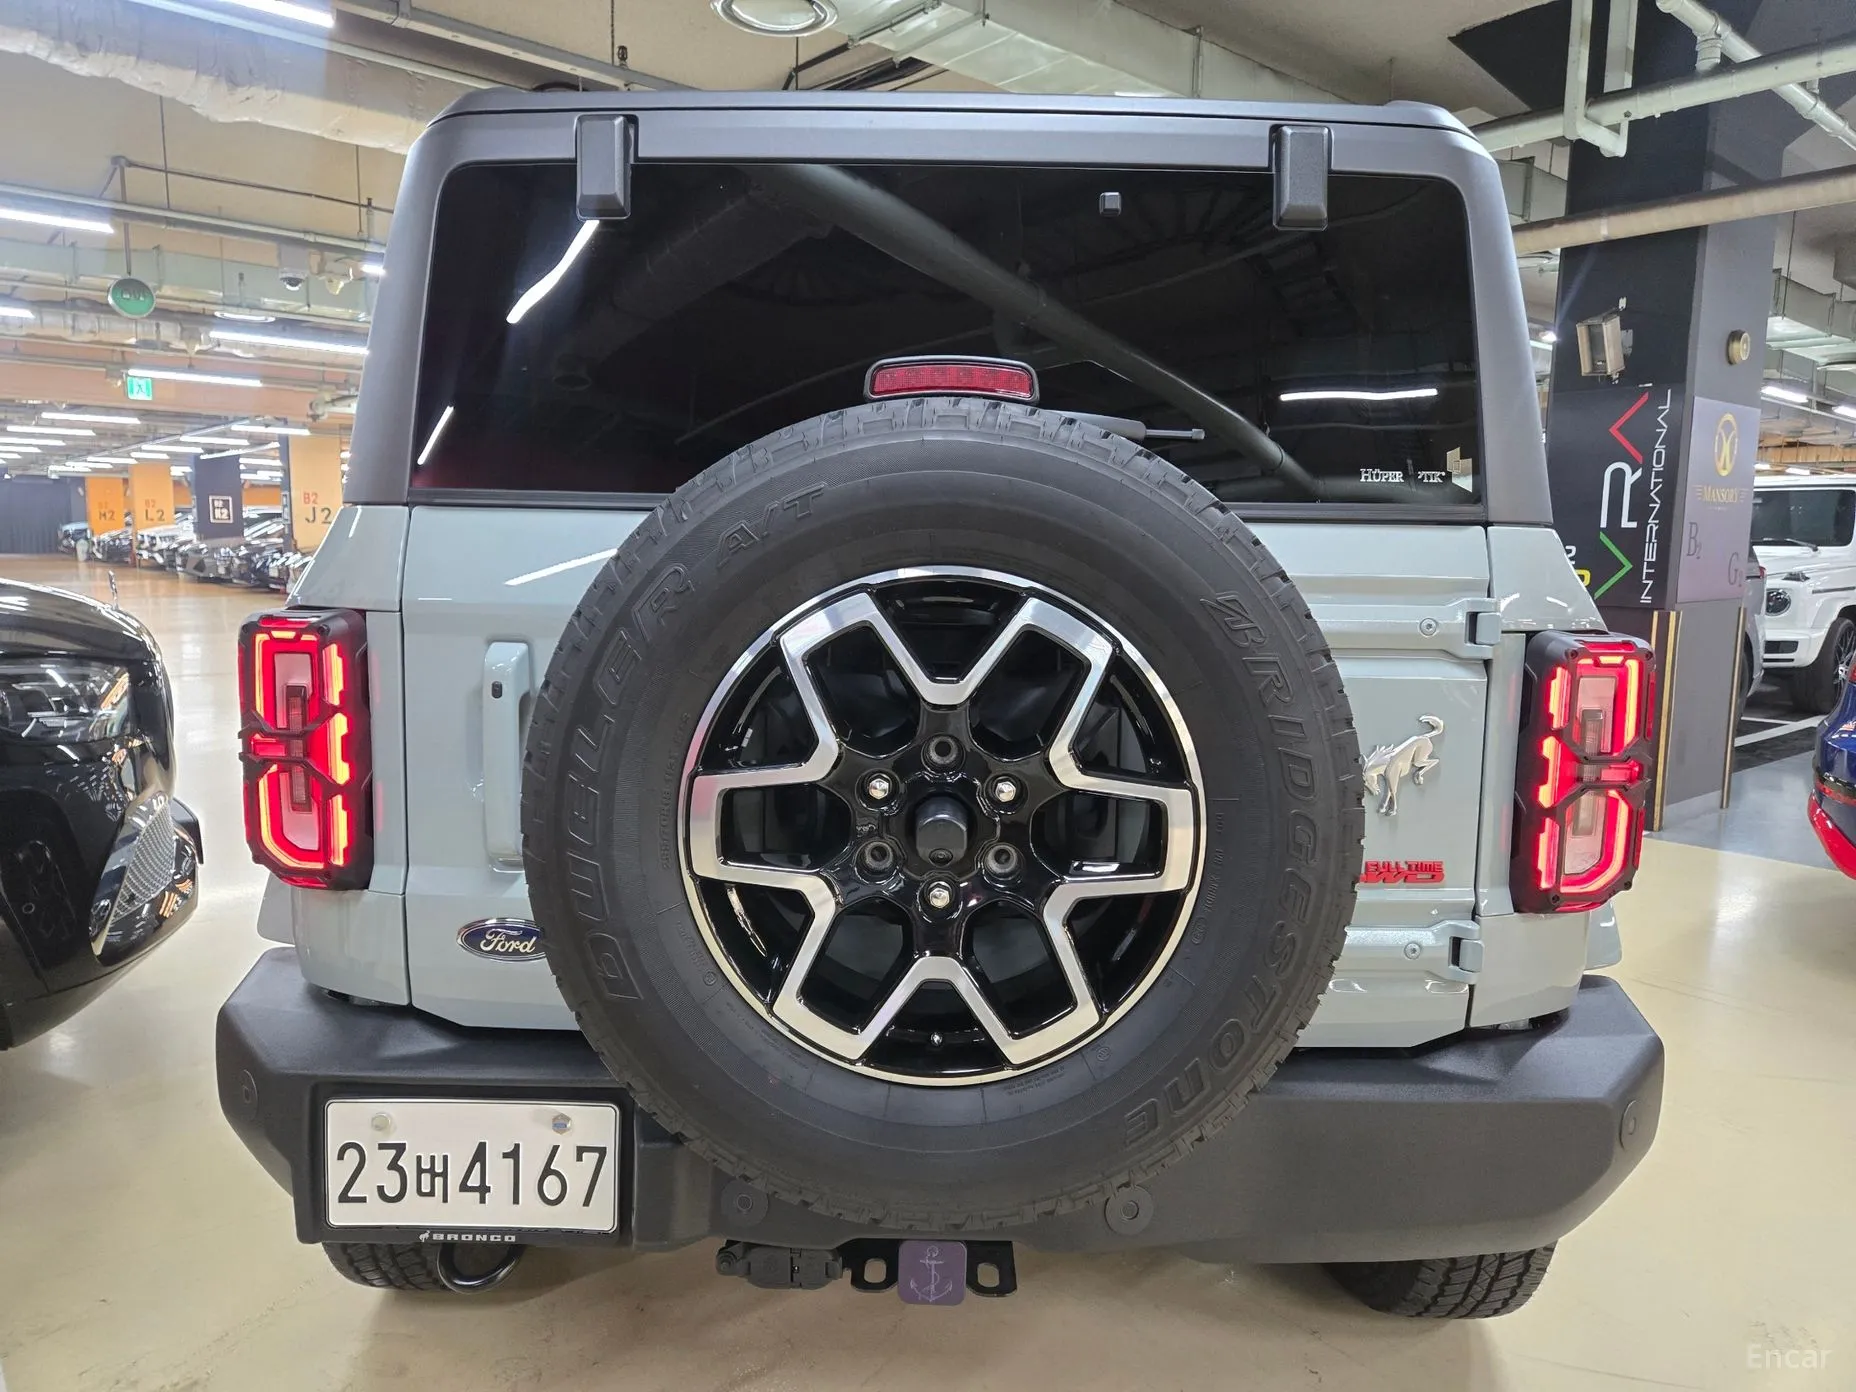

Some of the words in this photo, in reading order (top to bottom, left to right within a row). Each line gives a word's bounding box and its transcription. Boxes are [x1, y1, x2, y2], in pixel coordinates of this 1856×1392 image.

[1360, 469, 1404, 483] HÜPER
[303, 492, 318, 505] B2
[1640, 388, 1671, 603] INTERNATIONAL
[145, 508, 165, 521] L2
[305, 507, 332, 524] J2
[564, 562, 695, 1000] DUELER
[1122, 589, 1320, 1146] BRIDGESTONE
[1406, 861, 1443, 872] TIME
[479, 927, 538, 954] Ford
[336, 1141, 608, 1208] 23버4167
[432, 1233, 516, 1242] BRONCO
